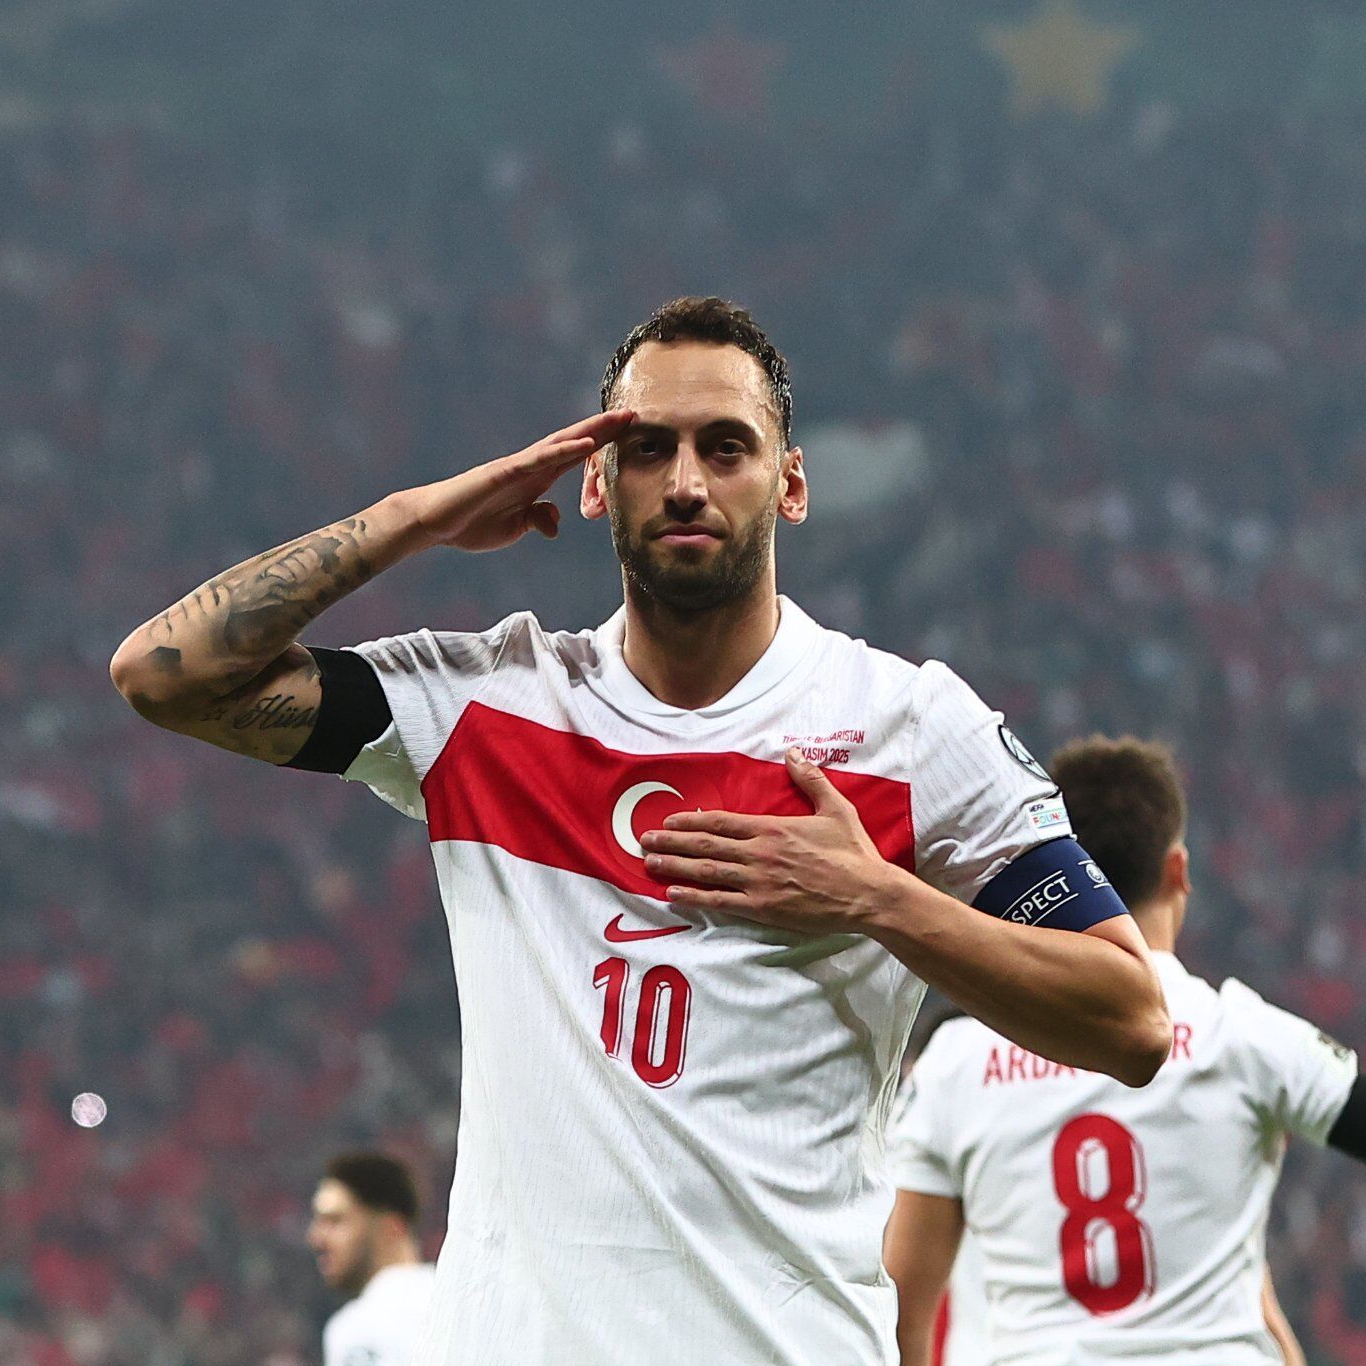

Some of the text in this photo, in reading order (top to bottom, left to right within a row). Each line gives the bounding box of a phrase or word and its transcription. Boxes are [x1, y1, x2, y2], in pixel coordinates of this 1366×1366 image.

[828, 748, 850, 764] 2025
[593, 956, 692, 1089] 10
[1051, 1112, 1155, 1319] 8
